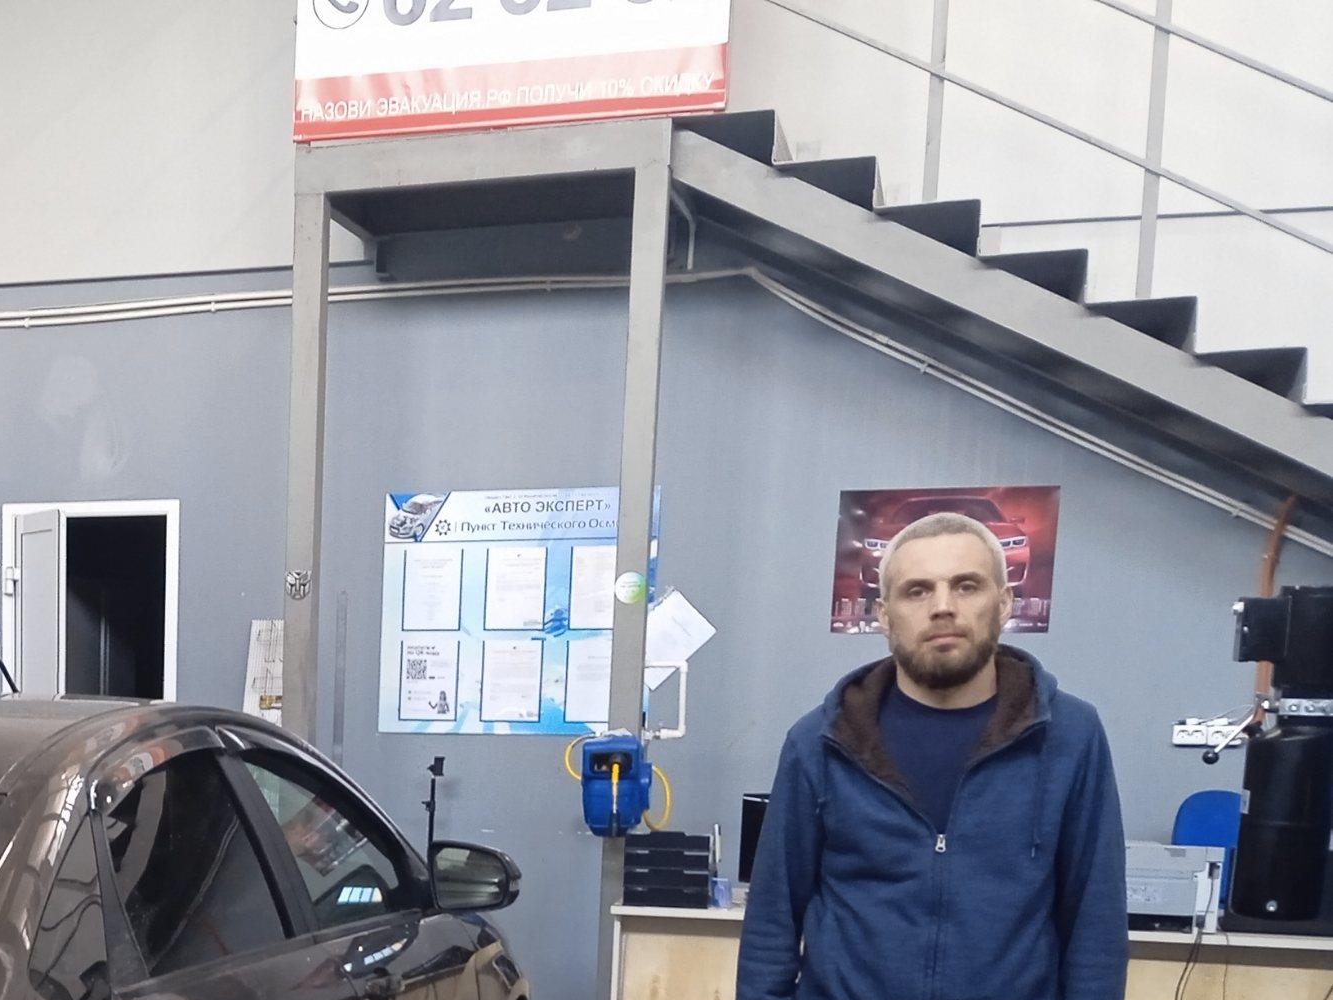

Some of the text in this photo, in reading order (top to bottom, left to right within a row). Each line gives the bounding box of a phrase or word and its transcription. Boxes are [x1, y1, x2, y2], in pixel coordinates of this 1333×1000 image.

[301, 72, 715, 122] НАЗОВИ ЭВАКУАЦИЯ.РФ ПОЛУЧИ 10% СКИДКУ
[484, 500, 611, 514] «АВТО ЭКСПЕРТ»
[461, 518, 617, 533] Пункт Технического Осм
